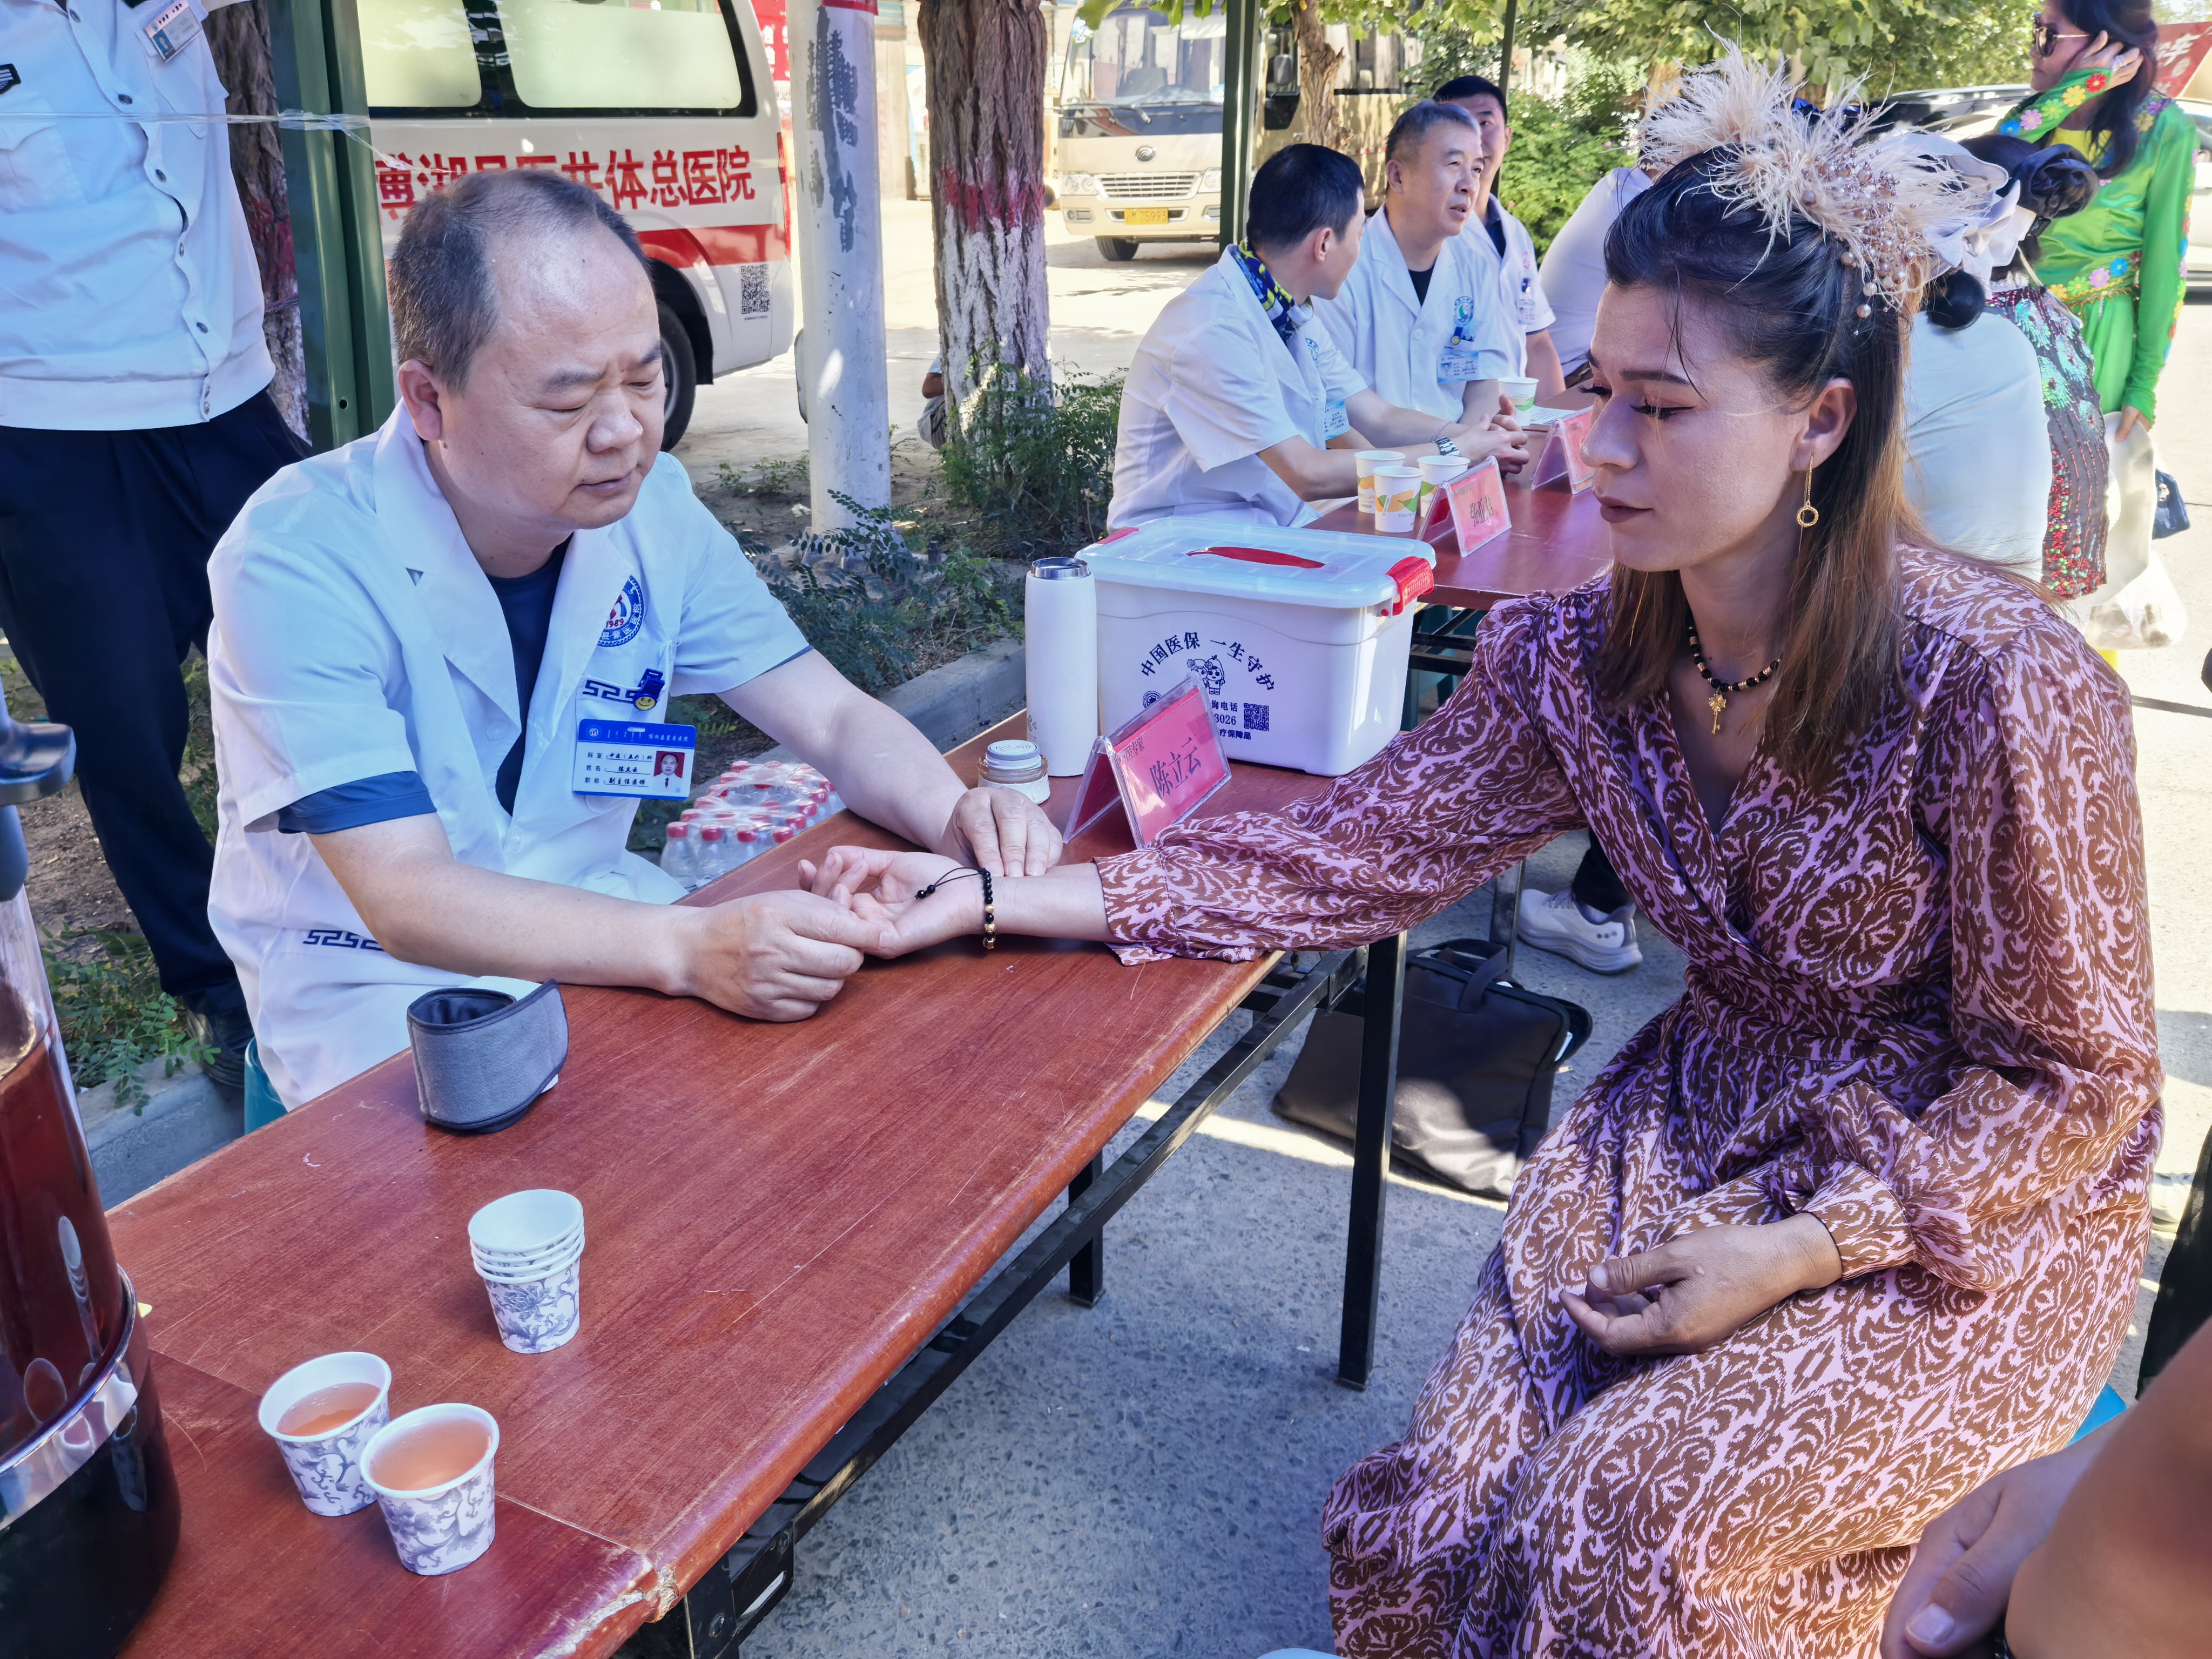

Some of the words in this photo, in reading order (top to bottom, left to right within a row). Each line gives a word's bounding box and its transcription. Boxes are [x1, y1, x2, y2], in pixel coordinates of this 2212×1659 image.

[1141, 631, 1201, 677] 中国医保
[1210, 638, 1275, 691] 一生守护
[1214, 713, 1236, 725] 3026
[1219, 729, 1251, 740] 疗保障局
[1149, 737, 1202, 800] 陈立云
